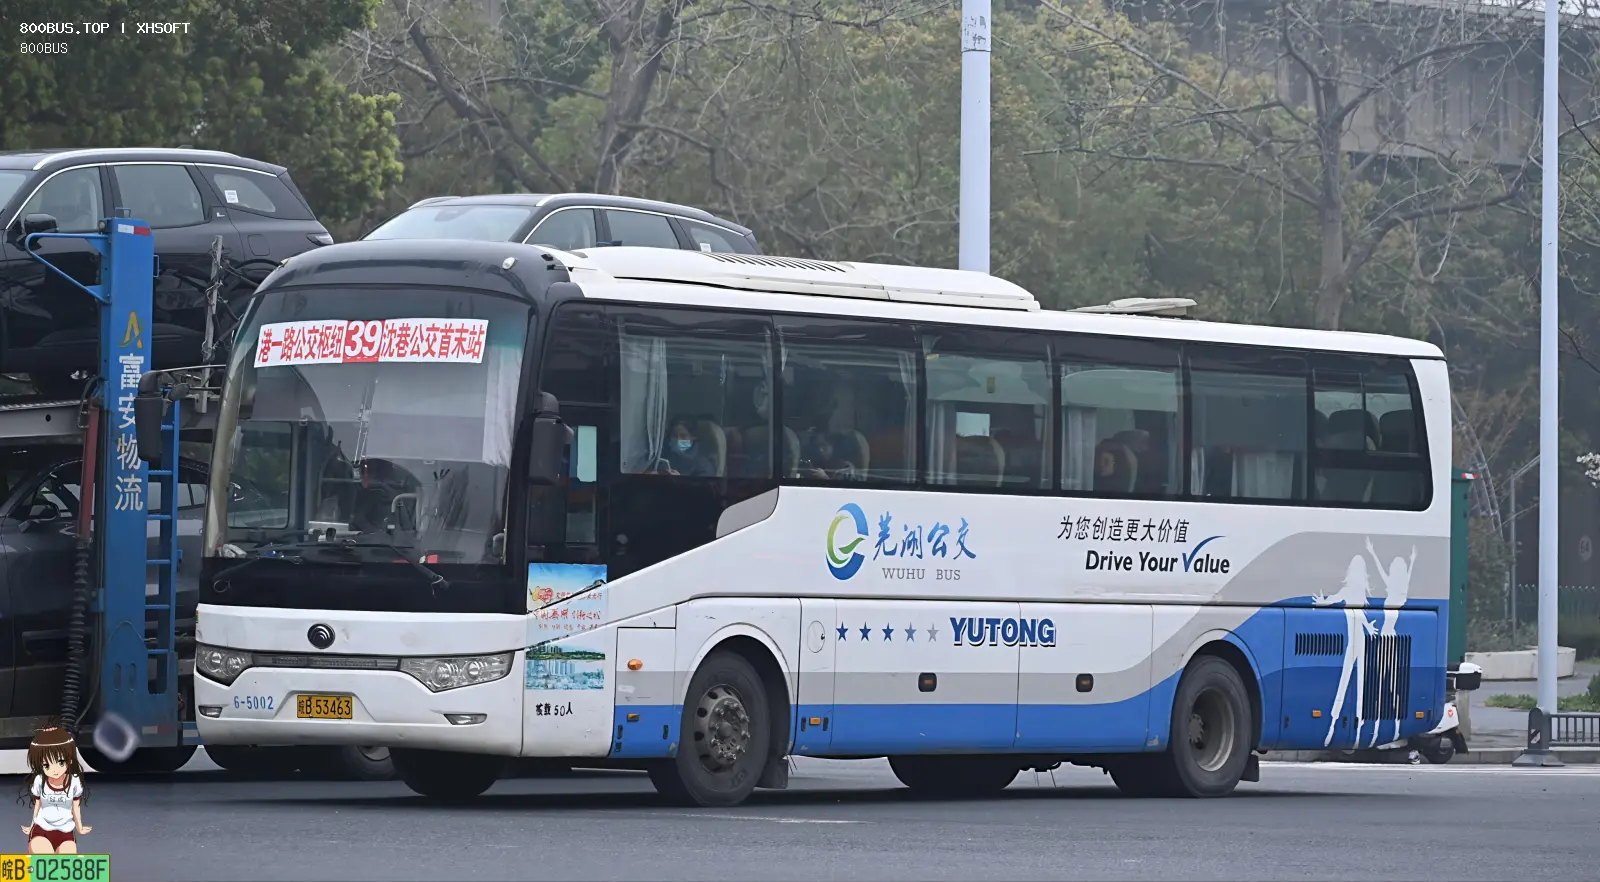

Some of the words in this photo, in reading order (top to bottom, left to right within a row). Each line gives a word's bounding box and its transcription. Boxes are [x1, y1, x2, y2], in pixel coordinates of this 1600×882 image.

[258, 325, 345, 363] 港一路公交枢纽
[345, 320, 383, 357] 39
[381, 322, 486, 360] 沈巷公交首末站
[873, 511, 977, 561] 芜湖公交
[1057, 515, 1190, 543] 为您创造更大价值
[1085, 550, 1133, 571] Drive
[1139, 551, 1178, 572] Your
[1182, 535, 1230, 573] Value
[881, 567, 925, 580] WUHU
[936, 569, 961, 581] BUS
[949, 617, 1057, 647] YUTONG
[233, 695, 274, 710] 6-5002
